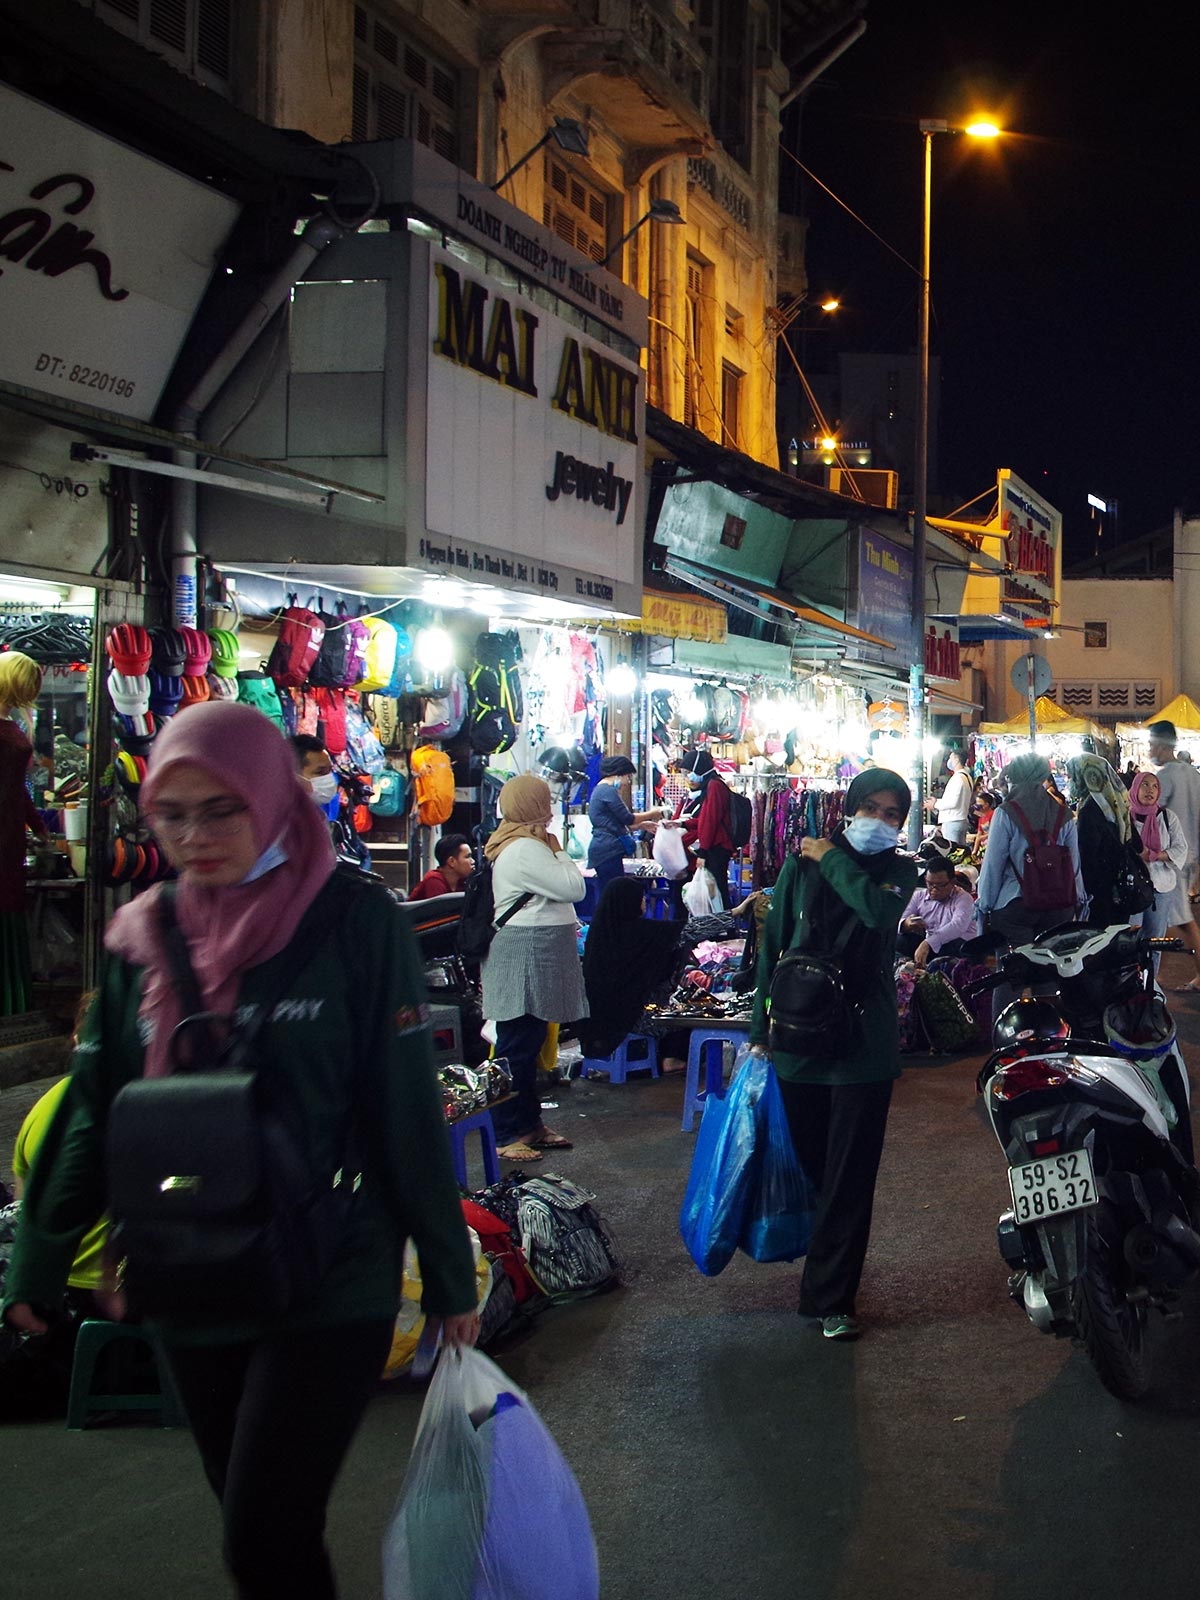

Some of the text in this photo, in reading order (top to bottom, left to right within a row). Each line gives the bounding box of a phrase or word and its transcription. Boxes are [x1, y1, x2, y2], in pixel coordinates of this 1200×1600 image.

[457, 193, 502, 244] DOANH
[434, 261, 640, 447] MAI ANH
[69, 365, 136, 398] 8220196
[381, 699, 392, 744] Superdr
[1021, 1154, 1081, 1190] 59-S2
[1018, 1179, 1093, 1219] 386.32
